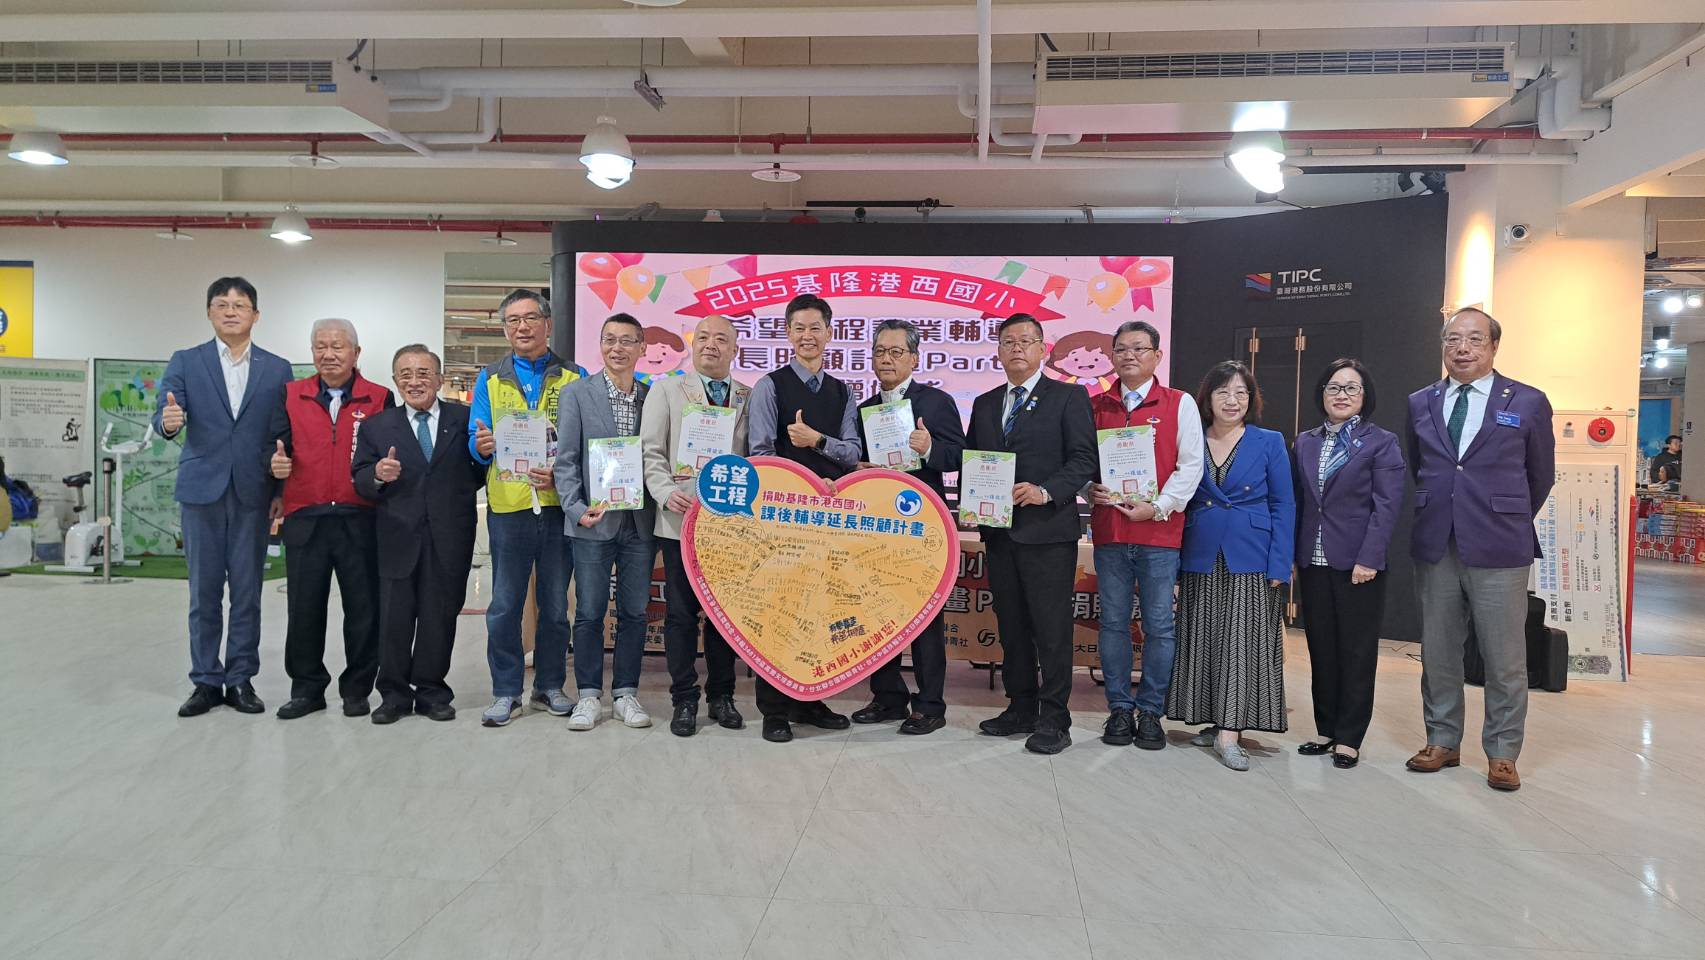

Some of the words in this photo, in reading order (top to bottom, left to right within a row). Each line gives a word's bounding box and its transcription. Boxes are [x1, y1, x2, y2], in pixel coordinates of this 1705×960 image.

[1278, 268, 1321, 283] TIPC
[710, 463, 750, 486] 希望
[708, 485, 747, 507] 工程
[763, 490, 866, 511] 捐助基隆市港西國小
[760, 505, 925, 537] 課後輔導延長照顧計畫
